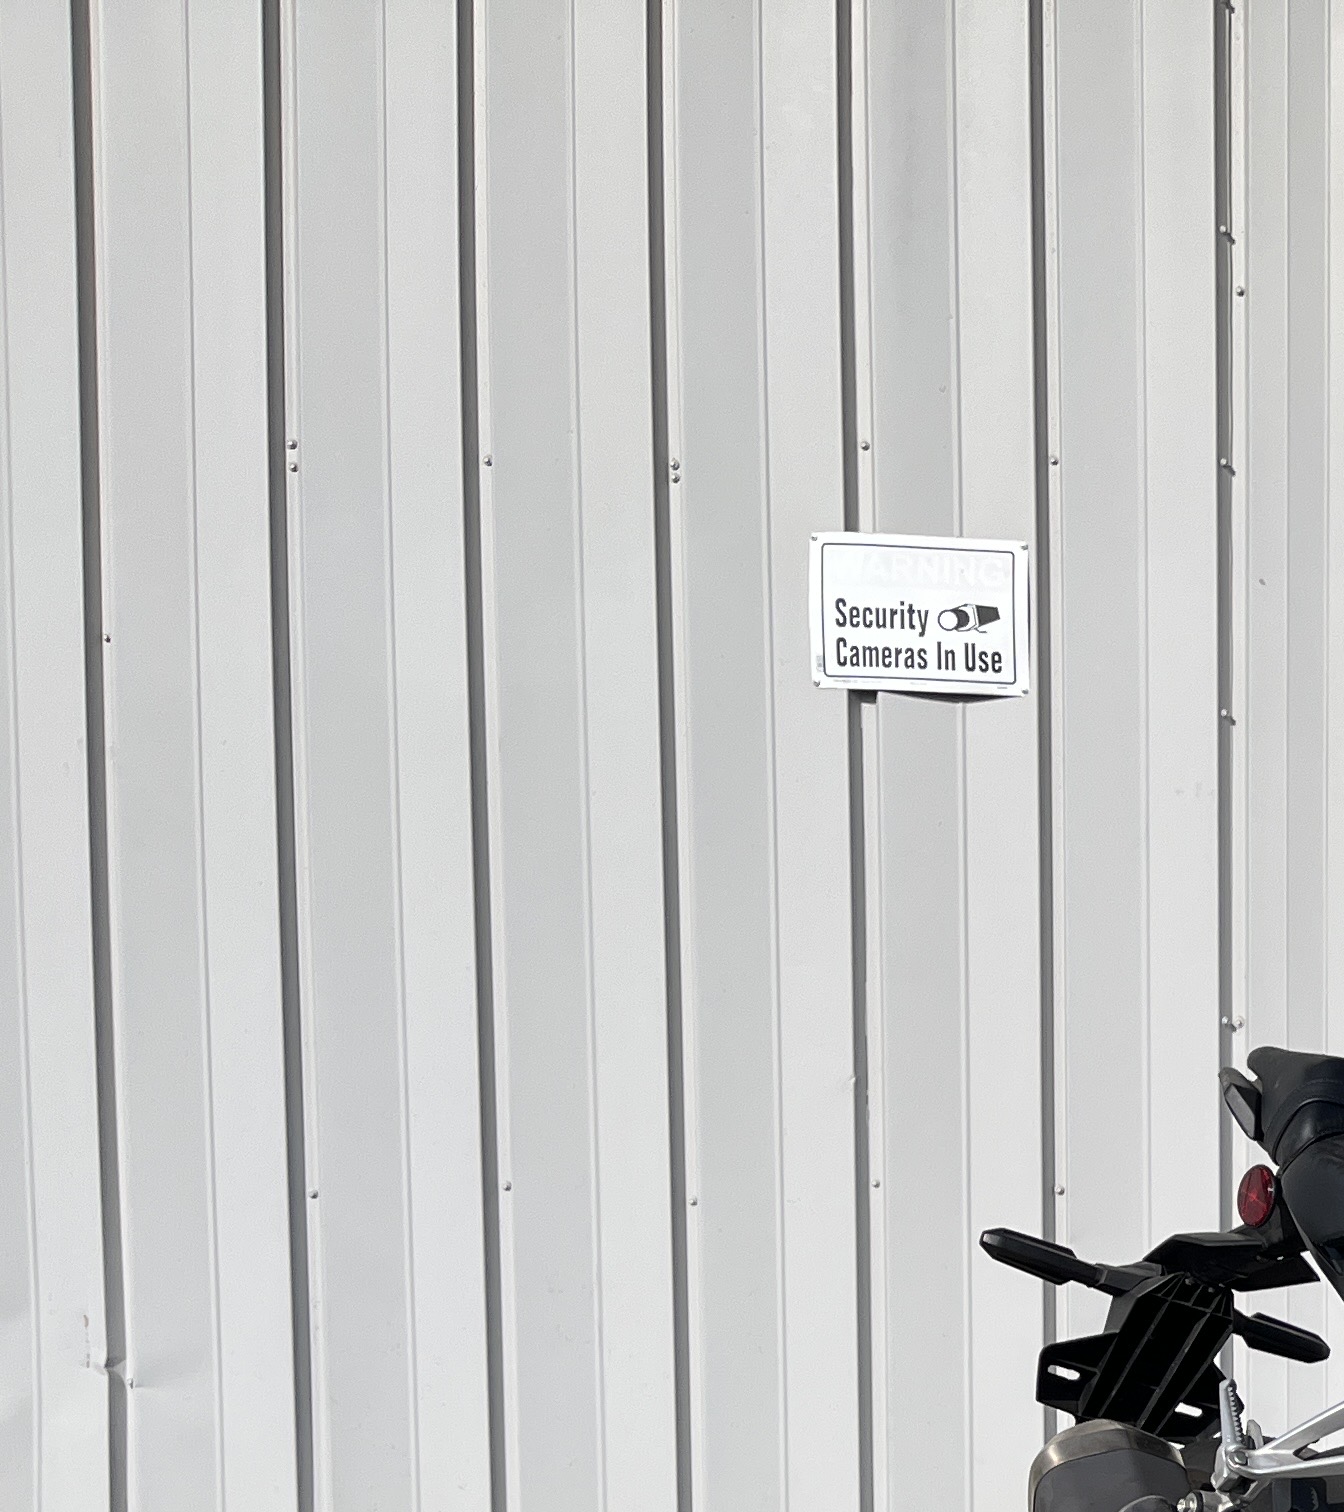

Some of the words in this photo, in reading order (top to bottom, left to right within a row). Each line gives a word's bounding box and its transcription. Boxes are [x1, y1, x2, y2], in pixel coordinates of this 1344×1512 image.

[829, 551, 1004, 587] ARNING
[834, 598, 929, 637] Security
[835, 637, 928, 670] Cameras
[936, 641, 956, 671] In
[964, 642, 1003, 674] Use
